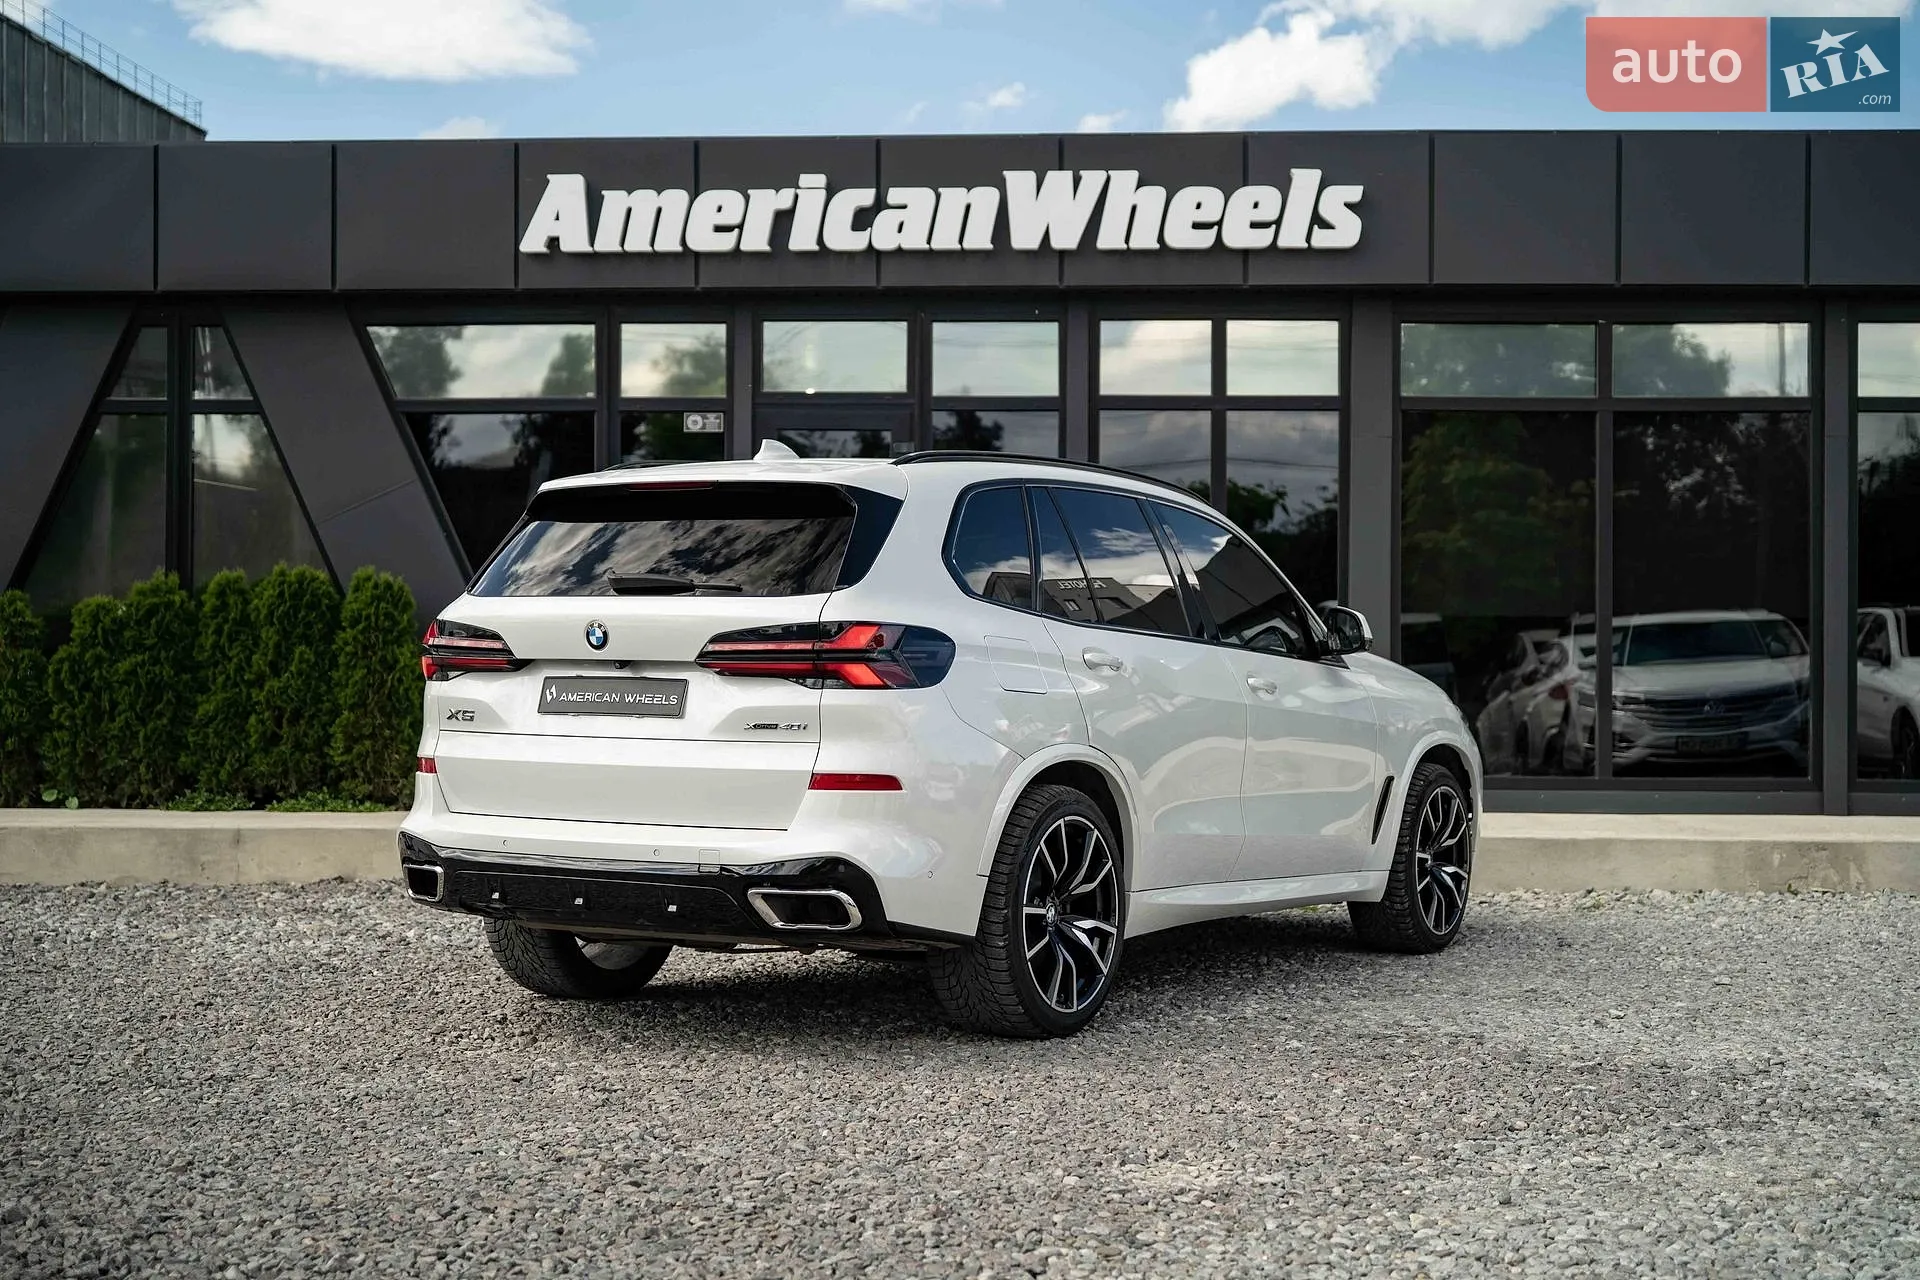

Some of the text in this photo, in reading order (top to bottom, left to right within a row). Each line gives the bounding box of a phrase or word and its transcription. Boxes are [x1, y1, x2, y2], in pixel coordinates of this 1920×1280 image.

[558, 692, 678, 705] AMERICAN WHEELS
[446, 708, 475, 721] X5
